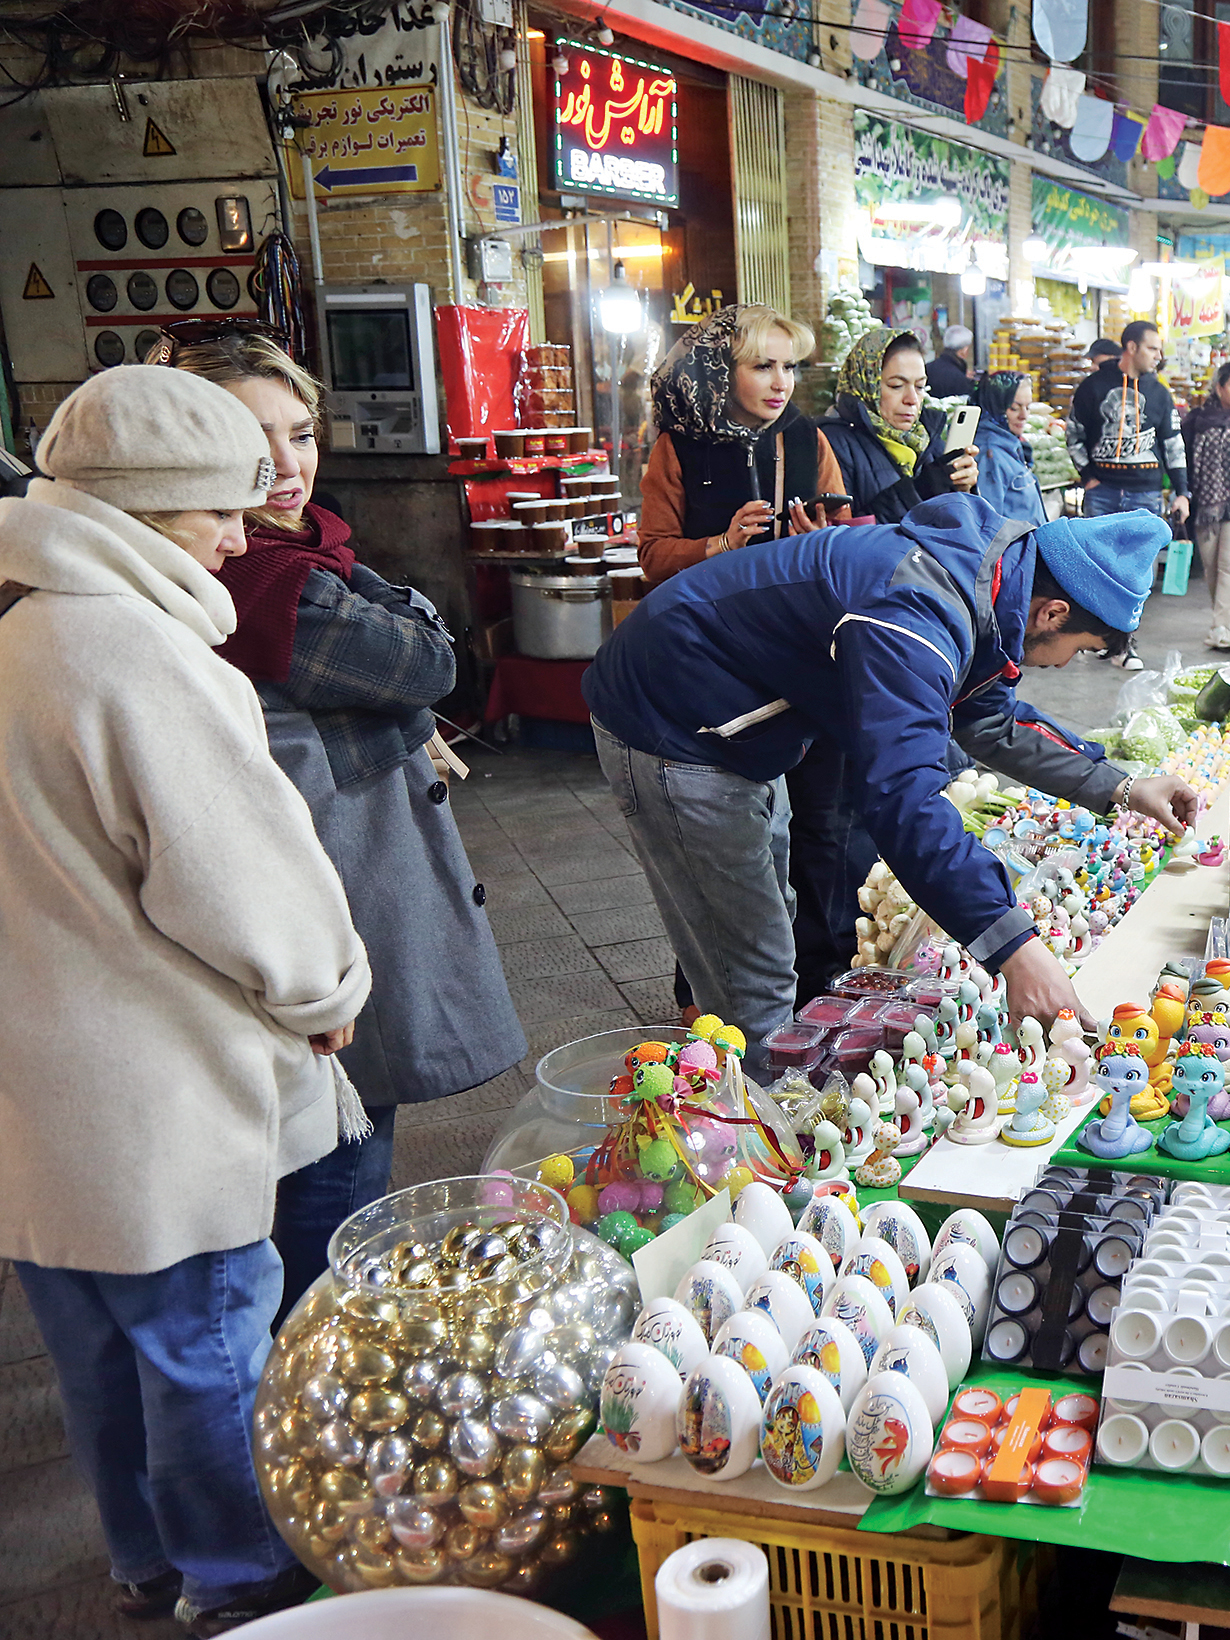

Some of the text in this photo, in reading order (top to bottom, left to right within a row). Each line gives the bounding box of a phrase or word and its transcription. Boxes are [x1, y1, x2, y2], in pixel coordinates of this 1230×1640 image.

[341, 97, 363, 126] نور
[366, 92, 430, 125] الکتریکی
[331, 131, 374, 158] لوازم
[377, 129, 426, 154] تعمیرات
[570, 148, 666, 194] BARBER
